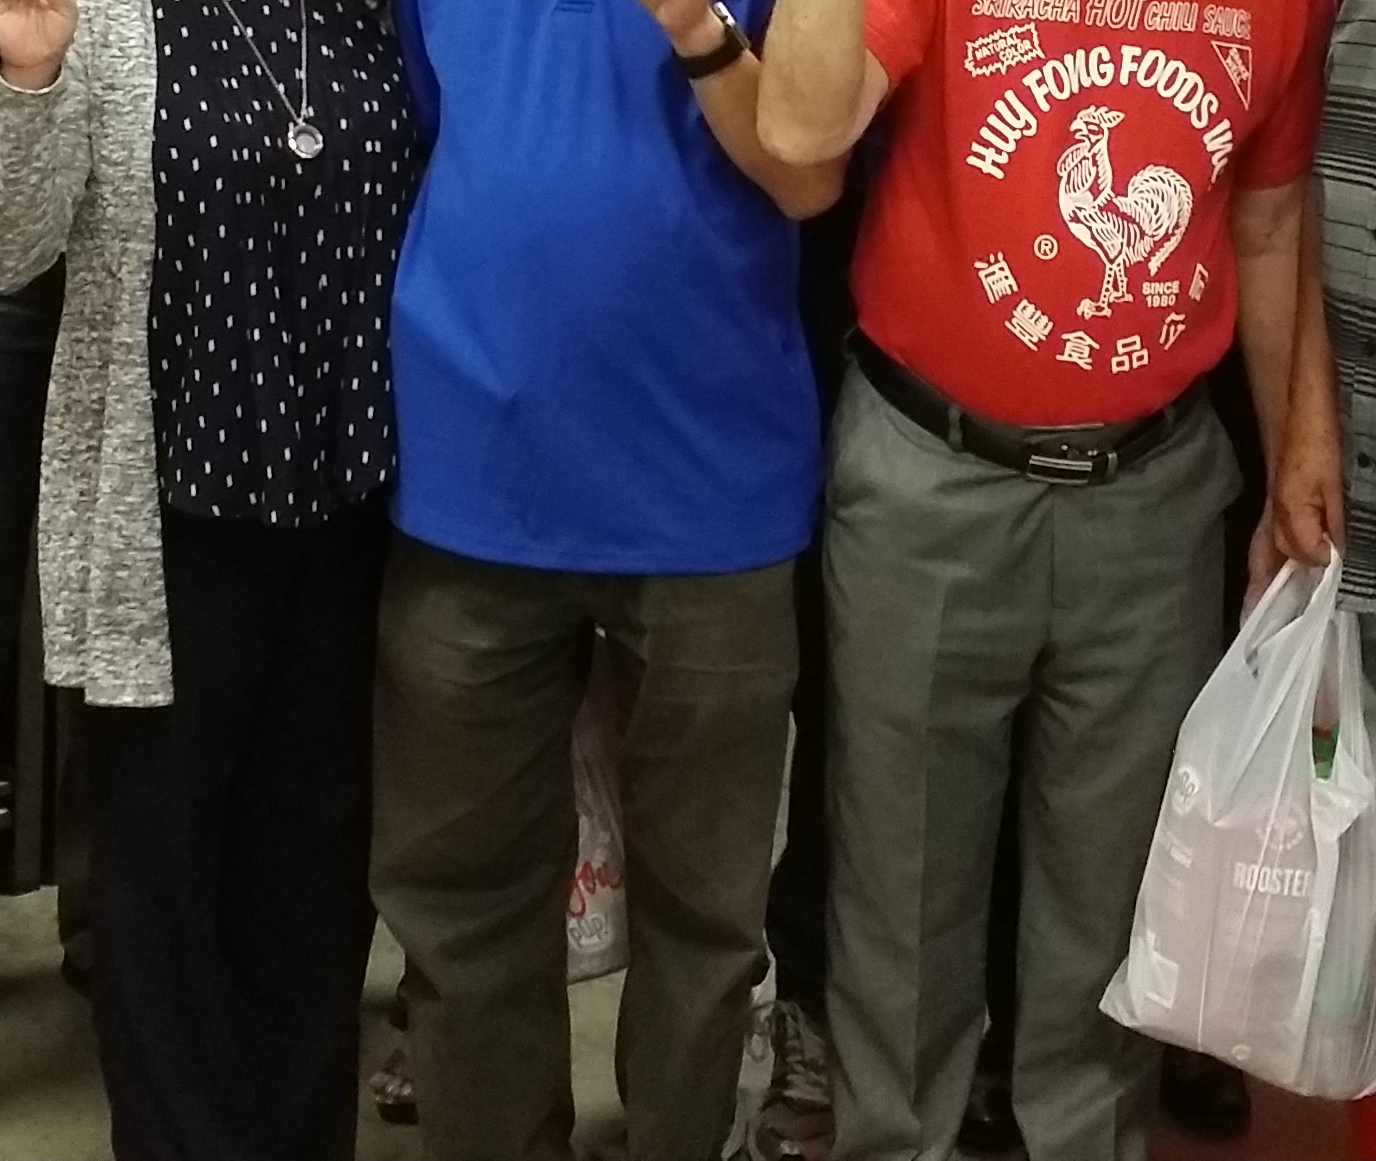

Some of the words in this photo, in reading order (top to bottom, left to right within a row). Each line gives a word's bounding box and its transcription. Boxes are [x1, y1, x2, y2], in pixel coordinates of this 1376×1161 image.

[1144, 0, 1198, 32] CHILI
[975, 32, 1021, 60] NATURAL
[999, 39, 1033, 61] COLOR
[966, 89, 1037, 180] HUY
[1022, 46, 1114, 112] FONG
[1119, 45, 1219, 129] FOODS
[1142, 280, 1180, 296] SINCE
[1146, 295, 1176, 308] 1980
